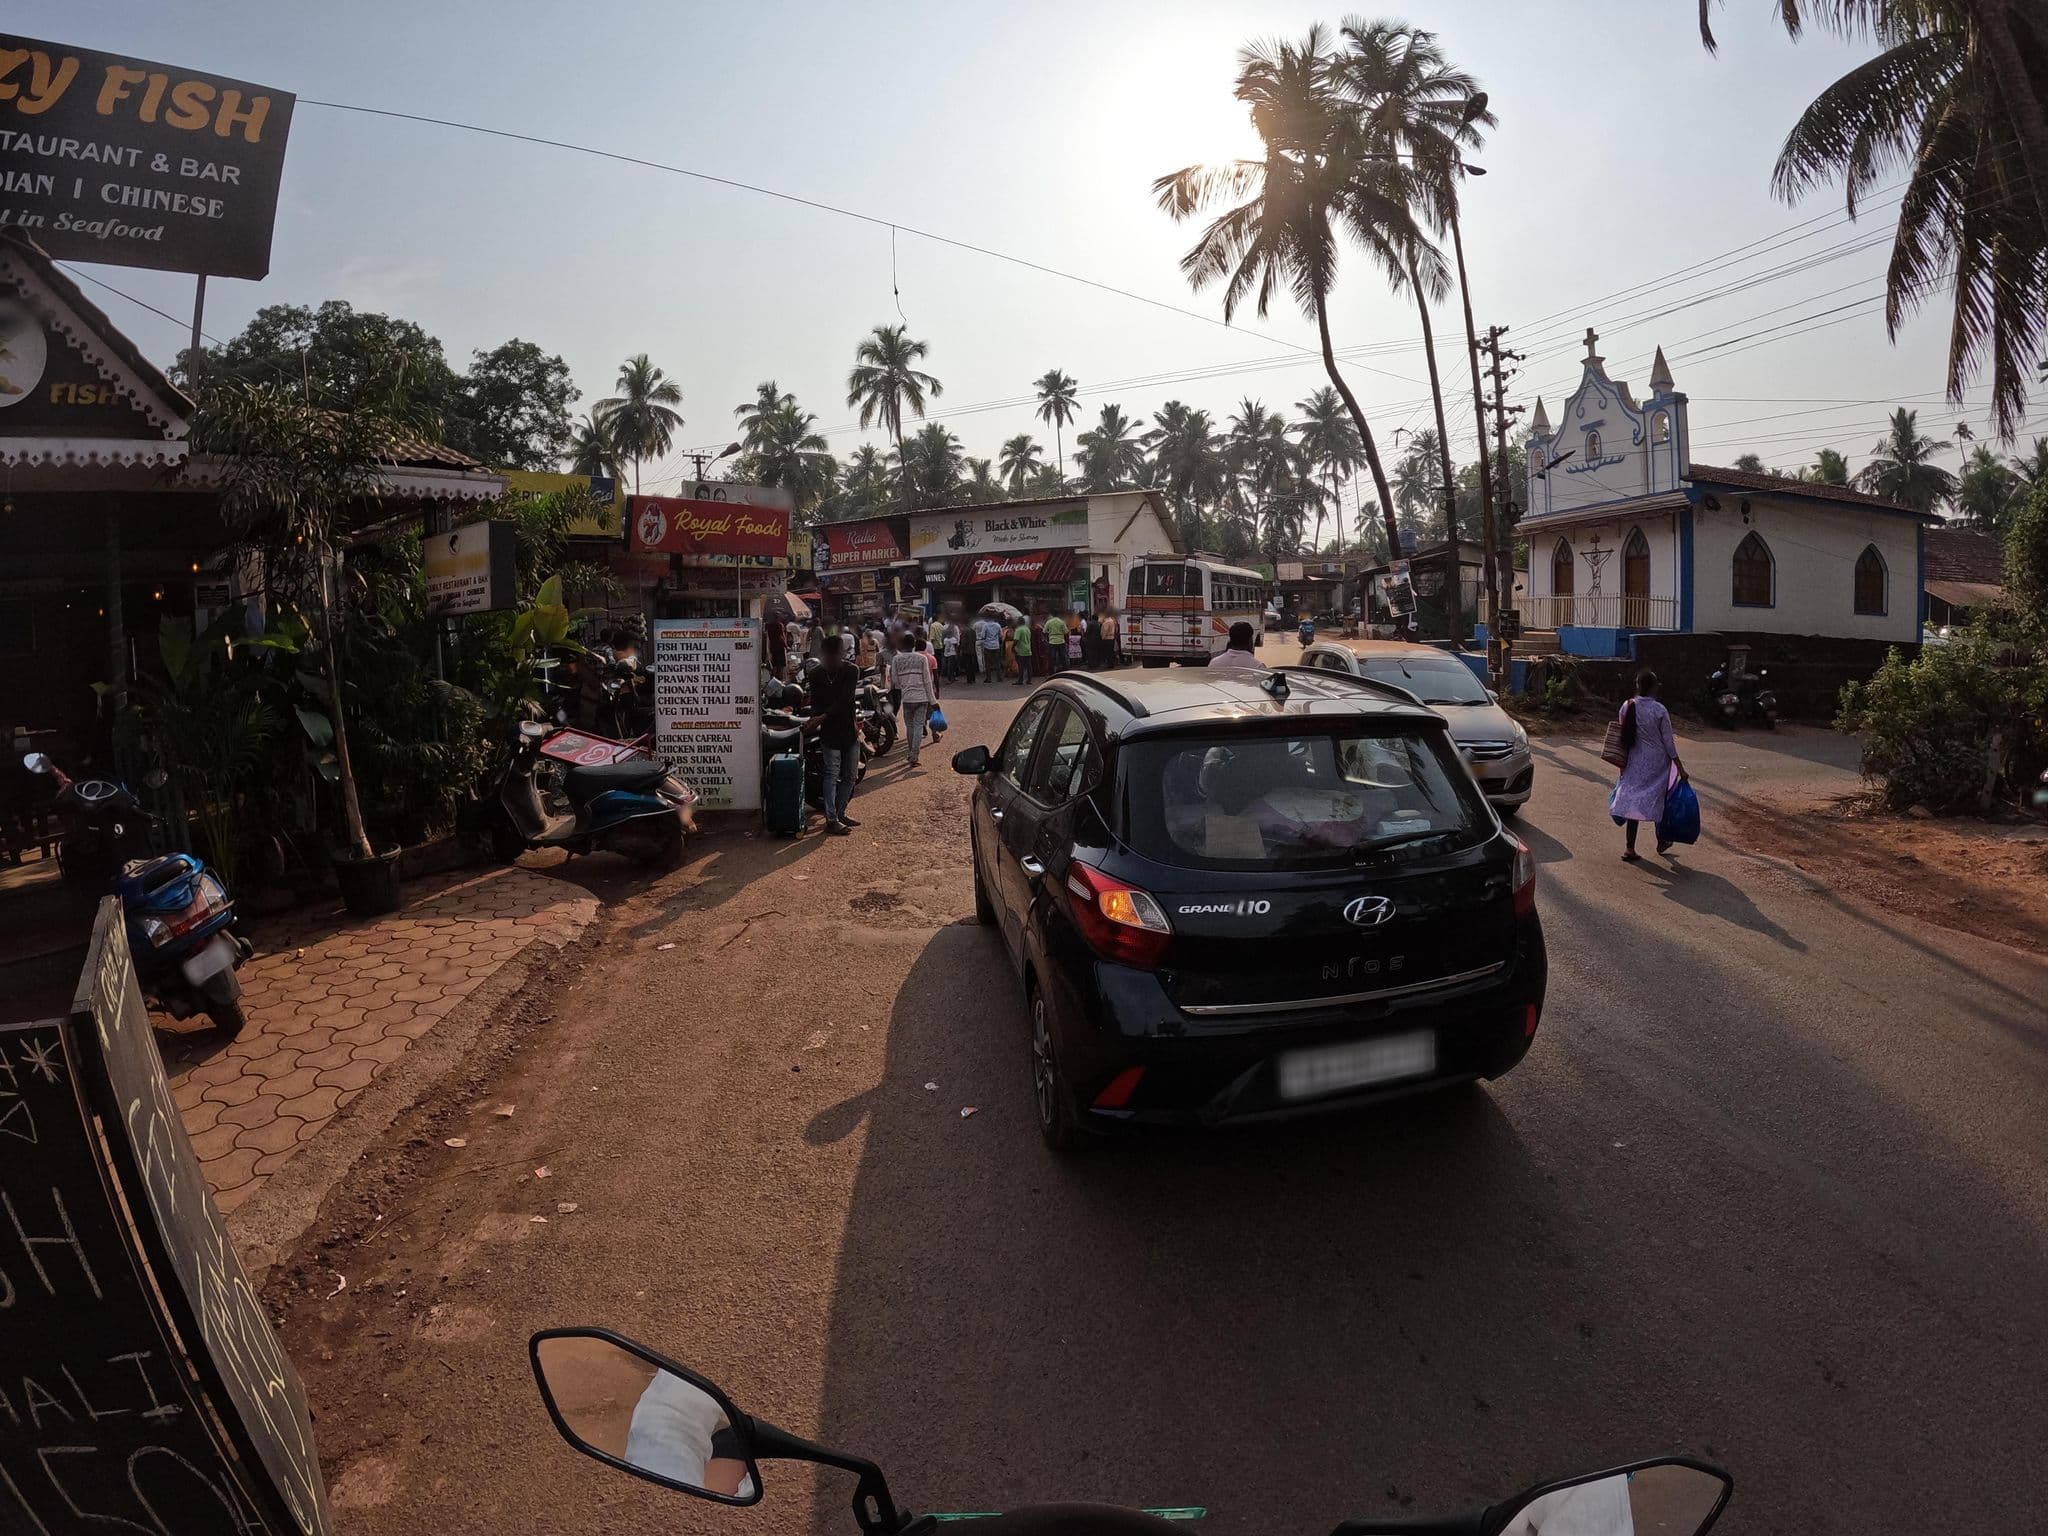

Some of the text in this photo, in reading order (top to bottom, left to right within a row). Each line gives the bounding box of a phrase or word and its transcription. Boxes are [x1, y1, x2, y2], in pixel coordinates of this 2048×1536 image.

[96, 65, 271, 144] FISH
[150, 153, 170, 174] &
[180, 157, 241, 185] BAR
[101, 183, 224, 219] CHINESE
[17, 210, 45, 228] in
[53, 212, 165, 242] Seafood
[674, 508, 782, 541] Royal Foods
[832, 551, 860, 563] SUPER
[974, 558, 1043, 575] Budweiser
[925, 574, 946, 583] WINES
[657, 643, 677, 651] FISH
[680, 643, 708, 651] THALI
[657, 653, 731, 661] POMFRET THALI
[657, 664, 731, 672] KINGFISH THALI
[657, 675, 730, 683] PRAWNS THALI
[657, 686, 730, 694] CHONAK THALI
[657, 696, 699, 704] CHICKEN
[702, 696, 730, 704] THALI
[658, 707, 677, 715] VEG
[680, 707, 709, 715] THALI
[658, 735, 732, 743] CHICKEN CAFREAL
[658, 745, 733, 753] CHICKEN BIRYANI
[690, 756, 722, 764] SUKHA
[697, 766, 727, 774] SUKHA
[701, 777, 733, 785] CHILLY
